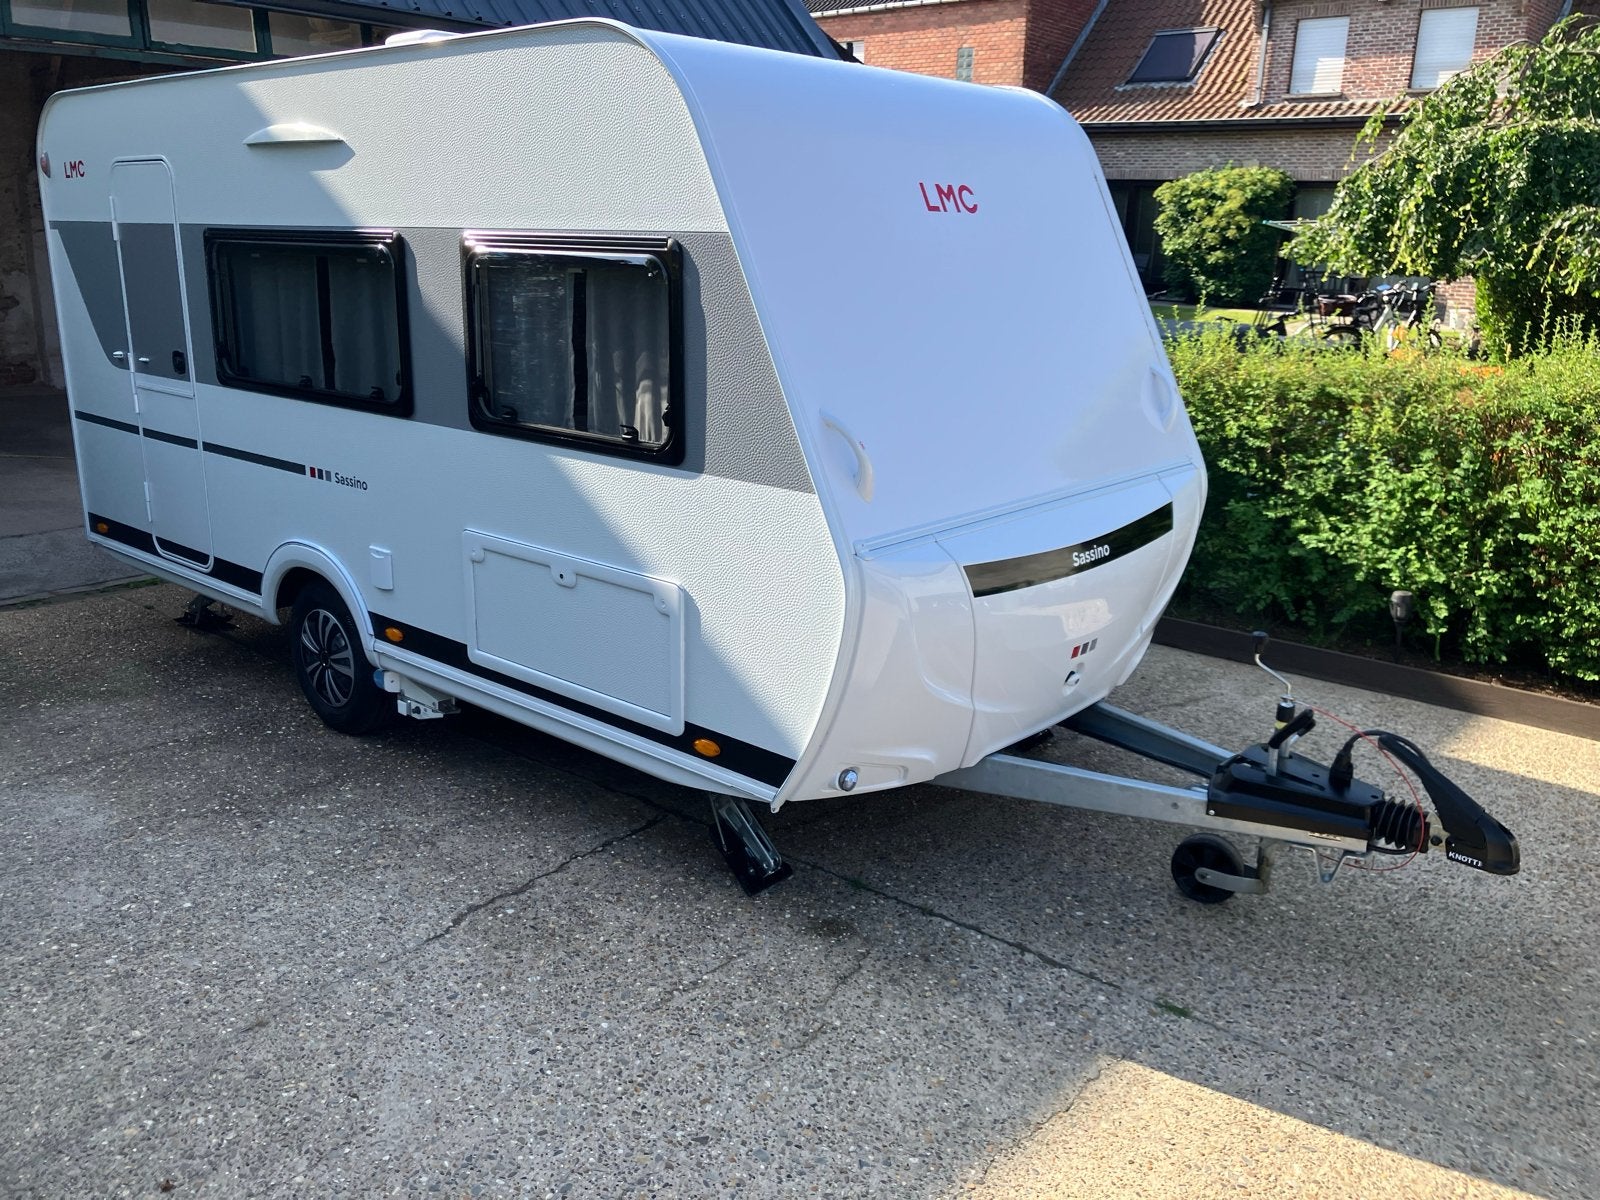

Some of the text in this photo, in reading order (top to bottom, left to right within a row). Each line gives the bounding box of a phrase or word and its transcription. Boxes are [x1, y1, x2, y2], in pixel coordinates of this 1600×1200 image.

[63, 160, 85, 178] LMC
[919, 182, 978, 214] LMC
[334, 472, 368, 490] Sassino
[1072, 544, 1110, 567] Sassino
